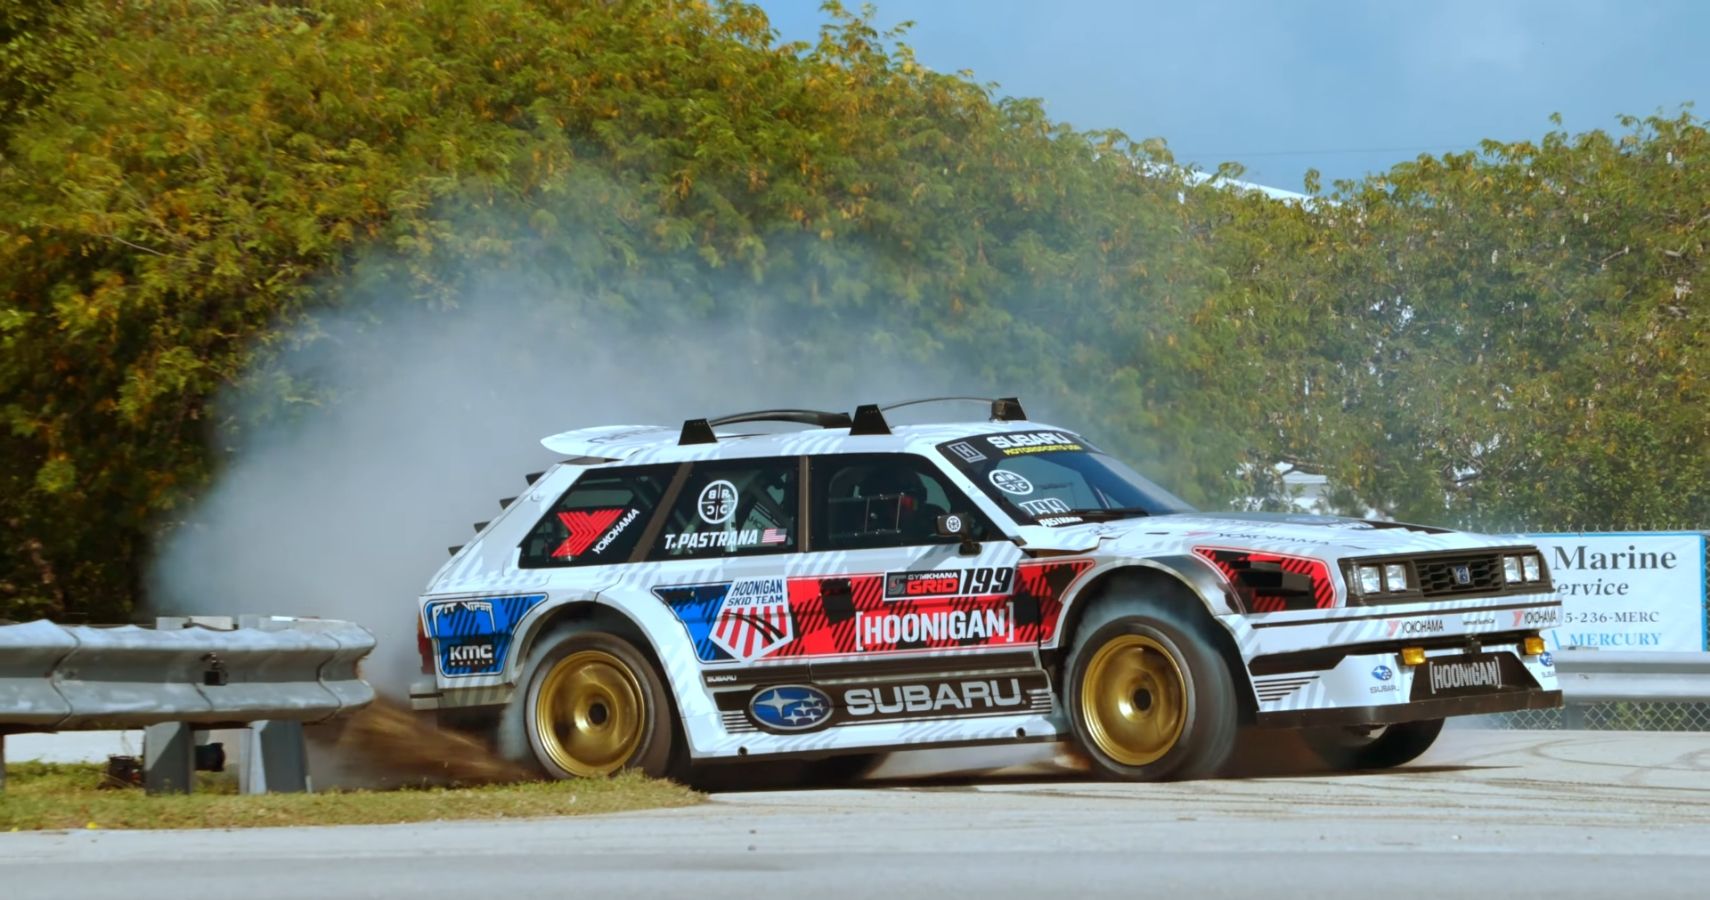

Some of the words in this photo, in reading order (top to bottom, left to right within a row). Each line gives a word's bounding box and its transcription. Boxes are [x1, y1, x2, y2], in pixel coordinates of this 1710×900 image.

[986, 432, 1072, 448] SUBARU
[592, 508, 640, 554] YOKOHAMA
[1553, 545, 1677, 570] Marine
[907, 571, 958, 581] GYMKHANA
[962, 567, 1014, 595] 199
[731, 579, 783, 597] HOONIGAN
[1553, 578, 1629, 596] ervice
[727, 597, 751, 606] SKID
[756, 595, 783, 604] TEAM
[1401, 620, 1444, 633] YOKOHAMA
[1570, 632, 1662, 645] MERCURY
[844, 678, 1022, 716] SUBARU
